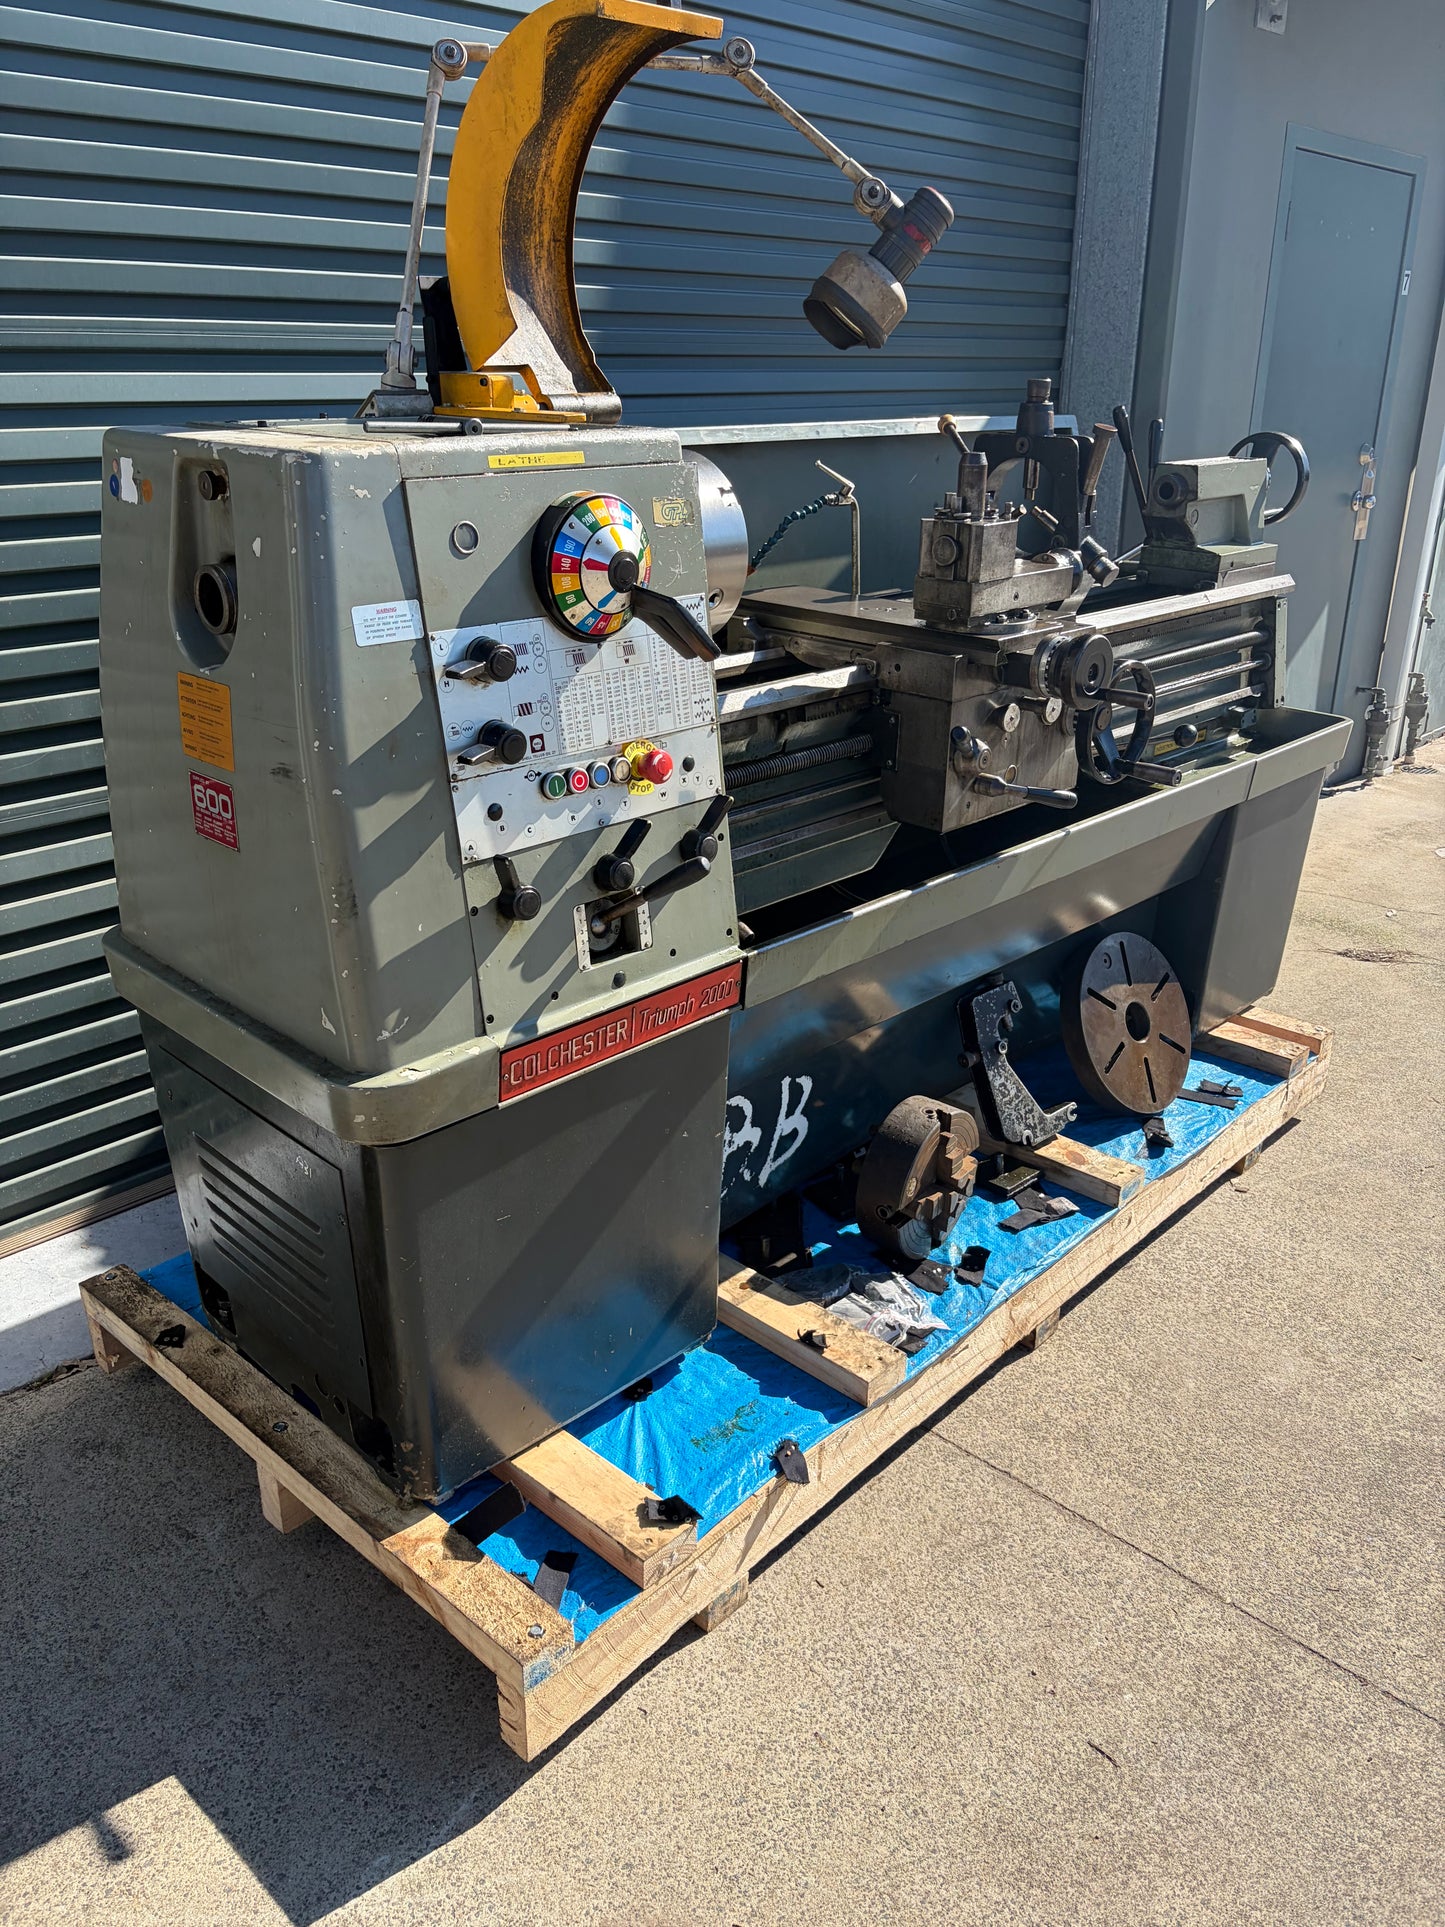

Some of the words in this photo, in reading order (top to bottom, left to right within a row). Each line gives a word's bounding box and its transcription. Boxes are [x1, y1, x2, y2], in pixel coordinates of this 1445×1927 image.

[1404, 274, 1410, 291] 7
[498, 456, 546, 466] LATHE
[582, 512, 596, 526] 260
[564, 540, 576, 552] 190
[561, 558, 572, 571] 140
[630, 783, 652, 793] STOP
[193, 783, 232, 820] 600
[509, 1018, 627, 1086] COLCHESTER
[640, 996, 695, 1032] Triumph
[700, 978, 734, 1008] 2000
